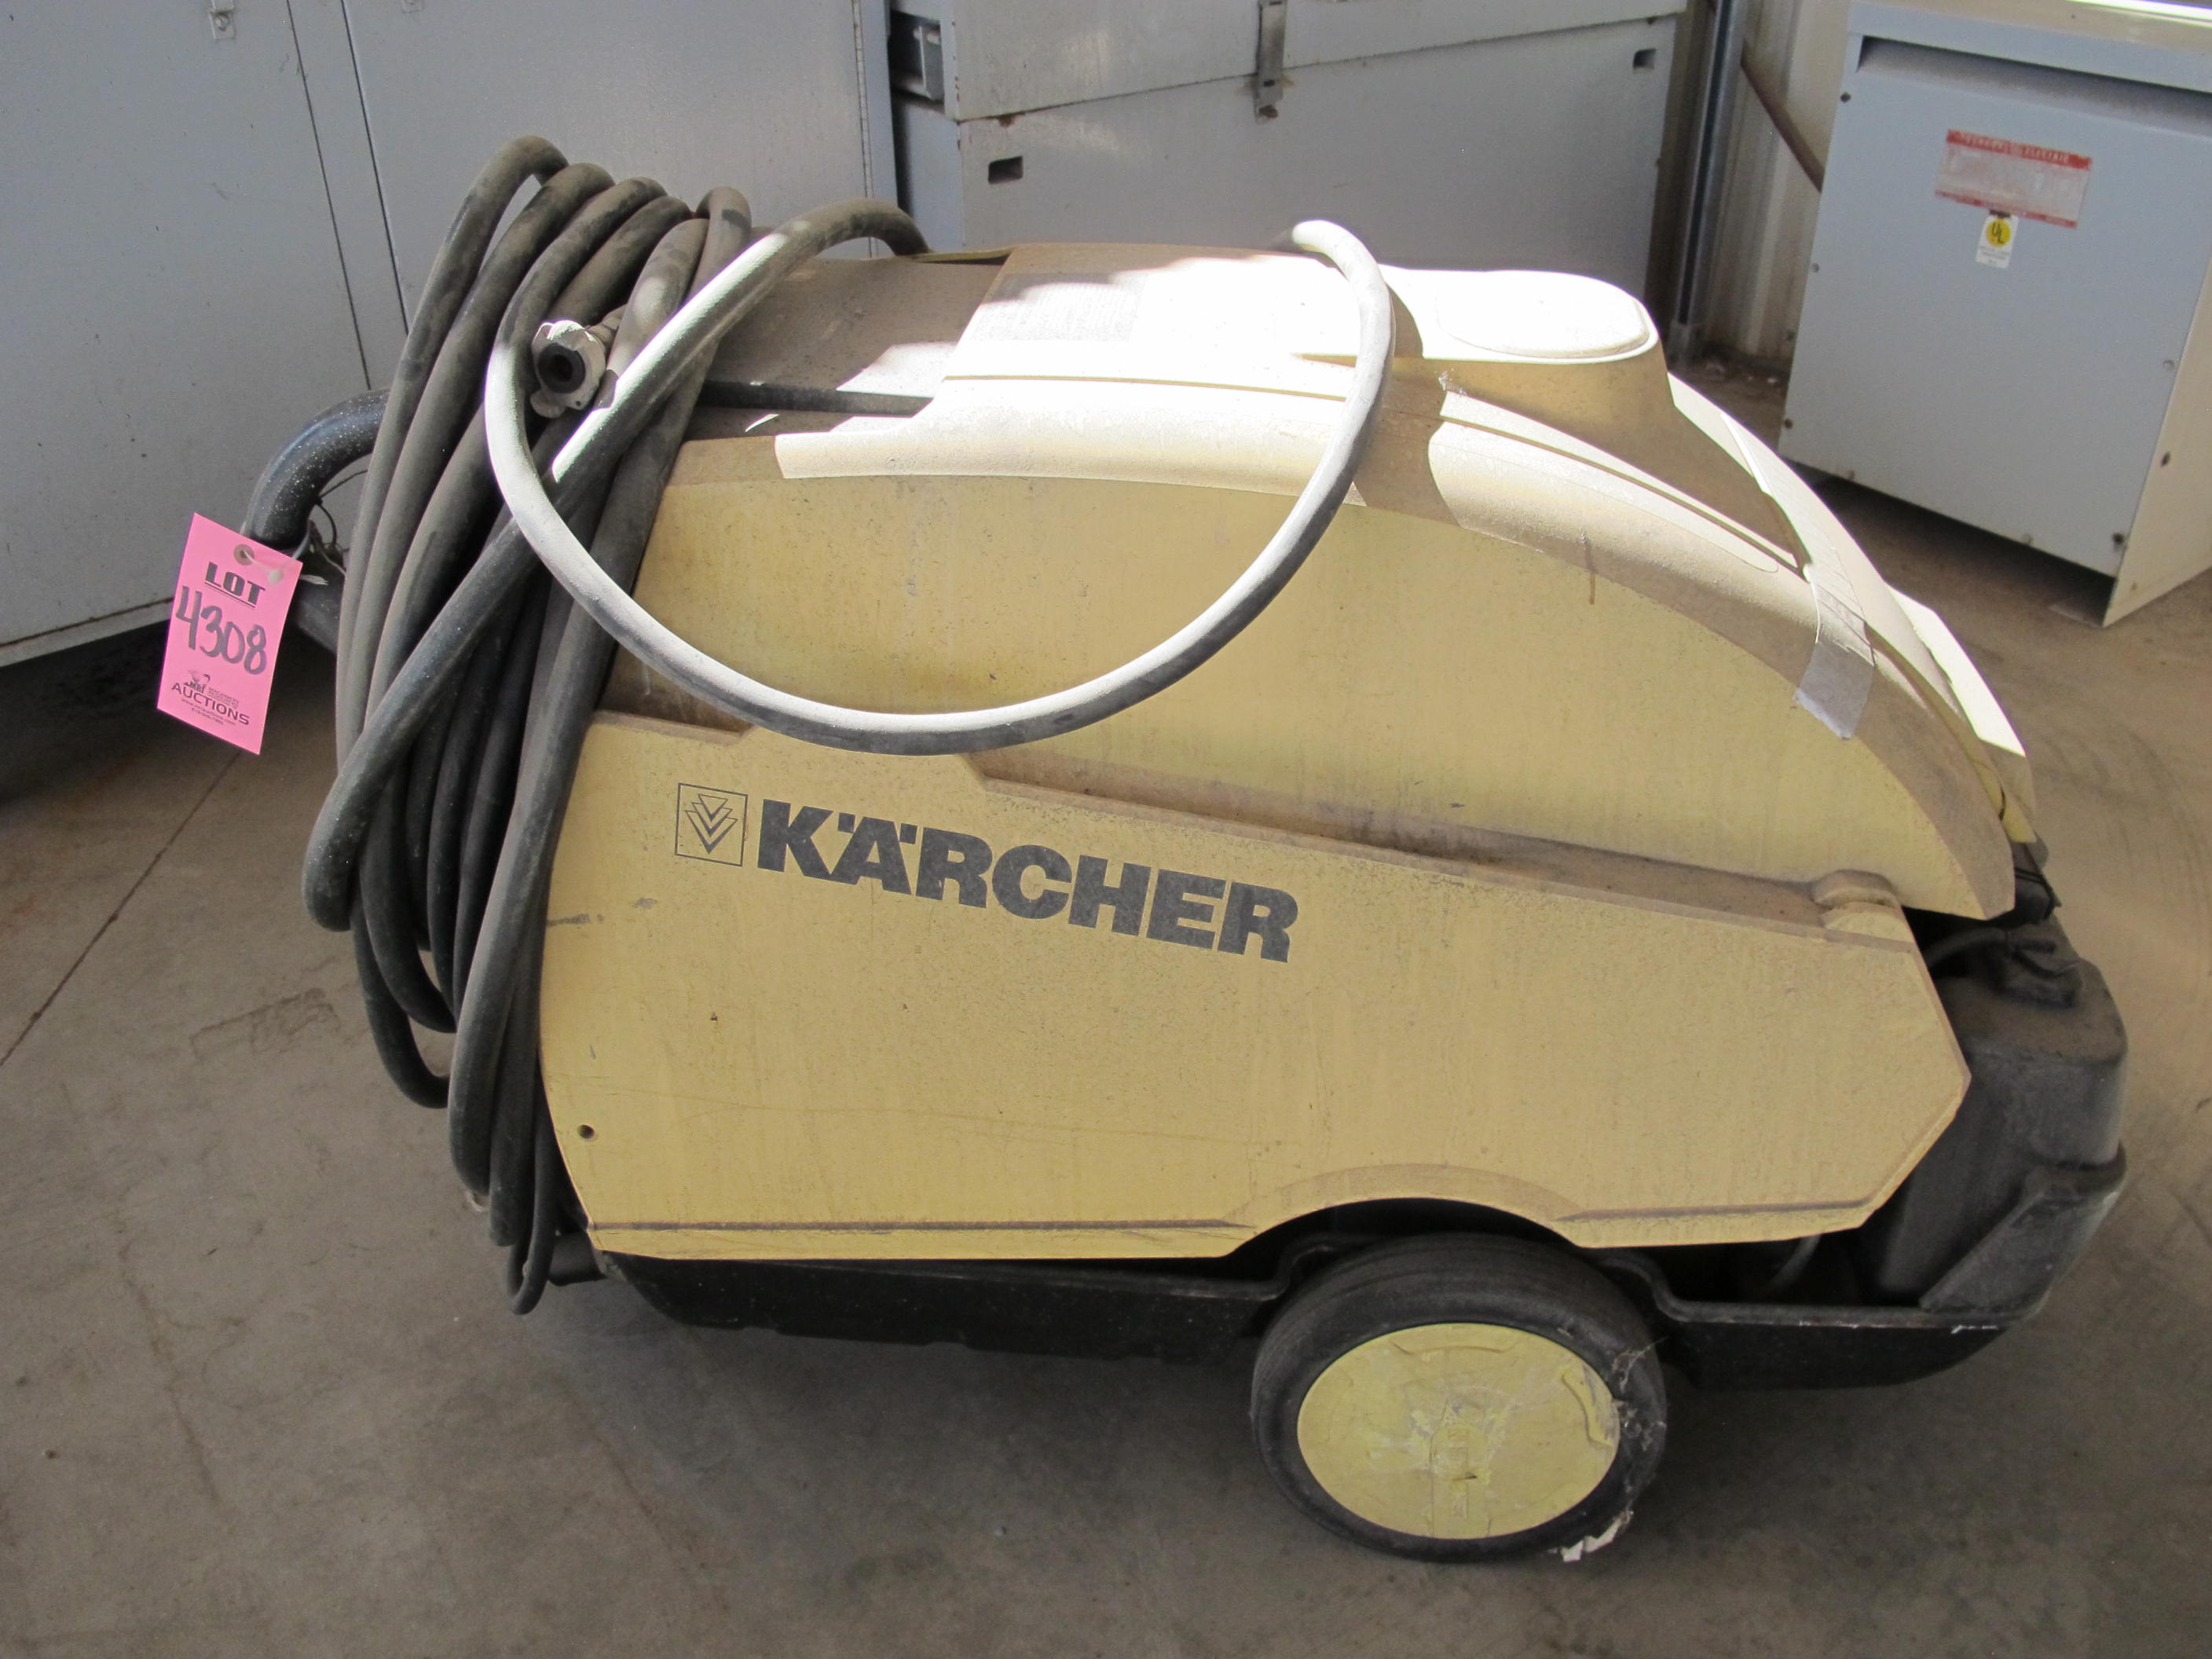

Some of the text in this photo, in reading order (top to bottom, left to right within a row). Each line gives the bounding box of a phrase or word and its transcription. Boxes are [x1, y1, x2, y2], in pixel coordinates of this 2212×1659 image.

[205, 561, 266, 606] LOT
[175, 585, 267, 675] 4308
[171, 682, 250, 725] AUCTIONS
[756, 798, 1299, 963] KÄRCHER
